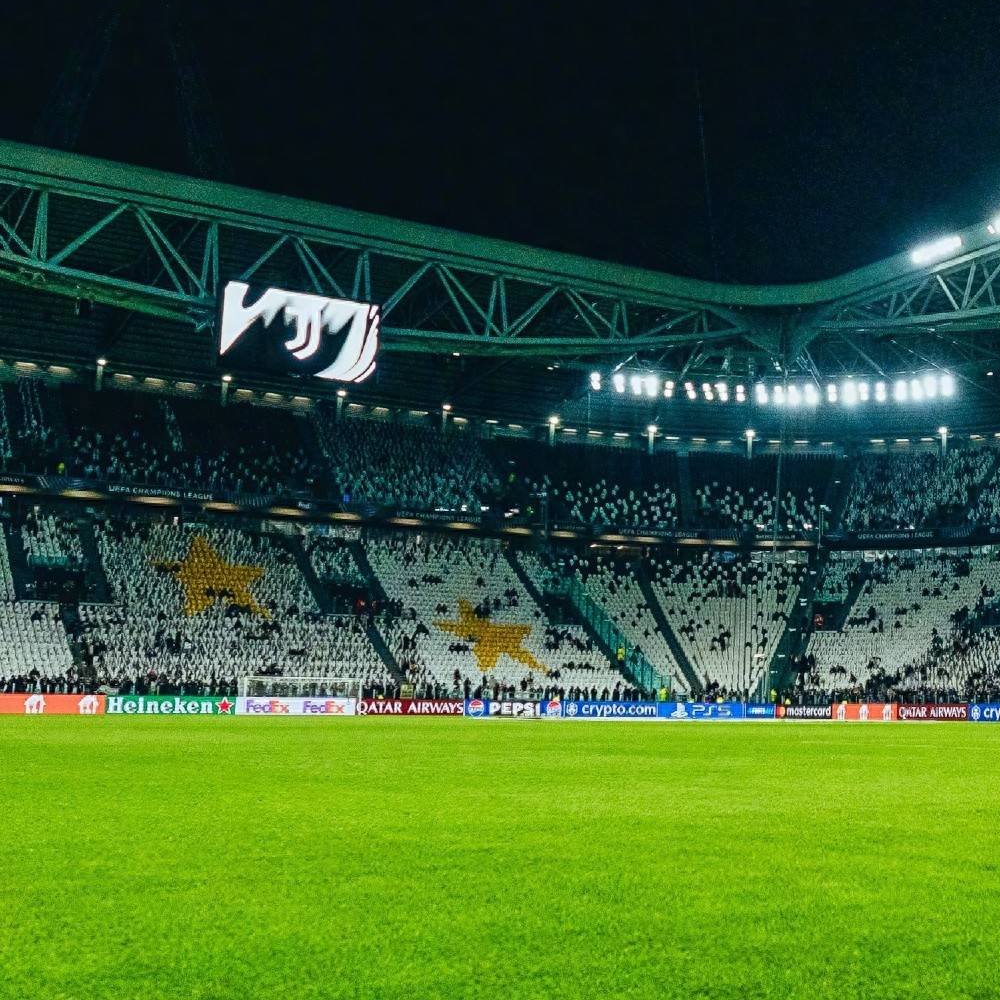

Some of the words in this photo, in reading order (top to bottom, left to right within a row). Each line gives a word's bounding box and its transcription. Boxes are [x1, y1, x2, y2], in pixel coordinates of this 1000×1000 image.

[107, 696, 213, 714] Heineken
[246, 699, 289, 713] FedEx
[303, 700, 345, 714] FedEx
[356, 701, 403, 715] QATAR
[407, 701, 463, 714] AIRWAYS
[489, 701, 540, 716] PEPSI
[582, 703, 656, 717] crypto.com
[692, 704, 731, 716] PS5
[786, 705, 831, 717] mastercard
[899, 706, 927, 719] QATAR
[930, 706, 967, 718] AIRWAYS
